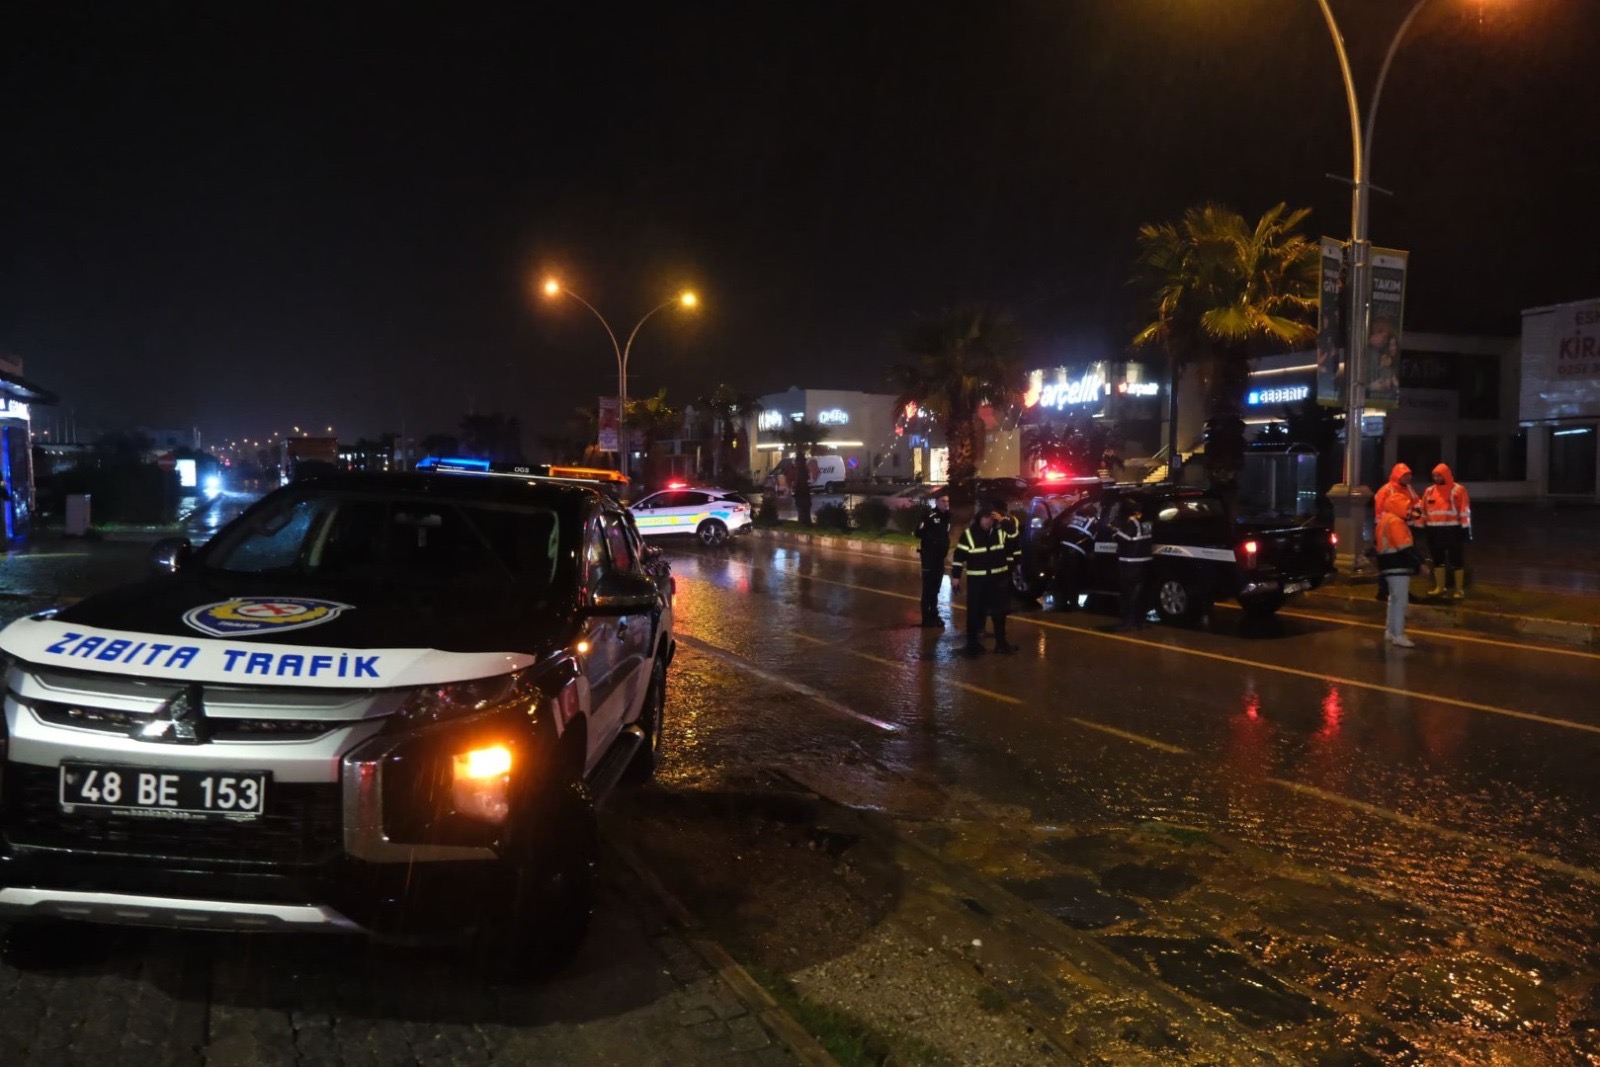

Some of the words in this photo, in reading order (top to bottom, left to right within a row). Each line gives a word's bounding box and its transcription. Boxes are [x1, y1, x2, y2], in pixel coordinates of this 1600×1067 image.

[1259, 386, 1309, 404] GEBERIT
[47, 633, 200, 669] ZABITA
[224, 649, 380, 678] TRAFİK
[81, 770, 121, 803] 48
[137, 773, 180, 806] BE
[200, 777, 259, 810] 153
